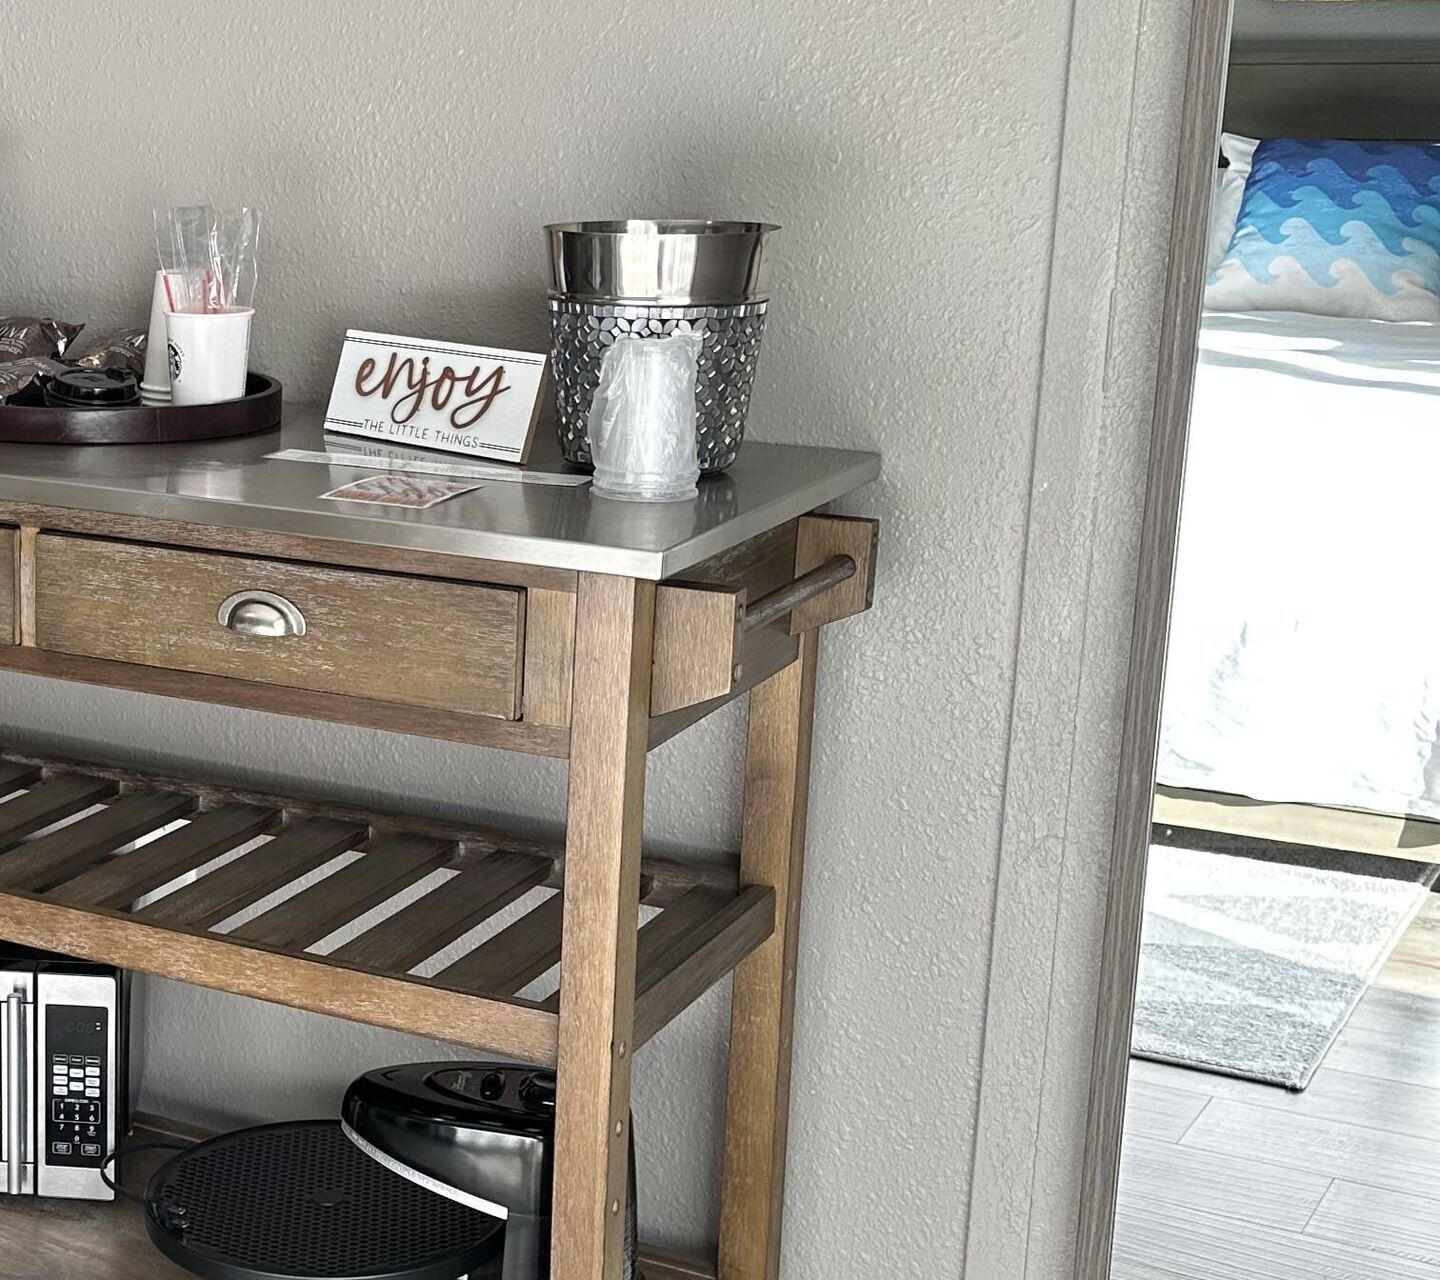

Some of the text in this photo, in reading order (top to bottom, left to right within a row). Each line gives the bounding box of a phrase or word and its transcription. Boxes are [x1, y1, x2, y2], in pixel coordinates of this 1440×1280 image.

[355, 352, 511, 429] enjoy
[363, 418, 480, 449] THE LITTLE THINGS
